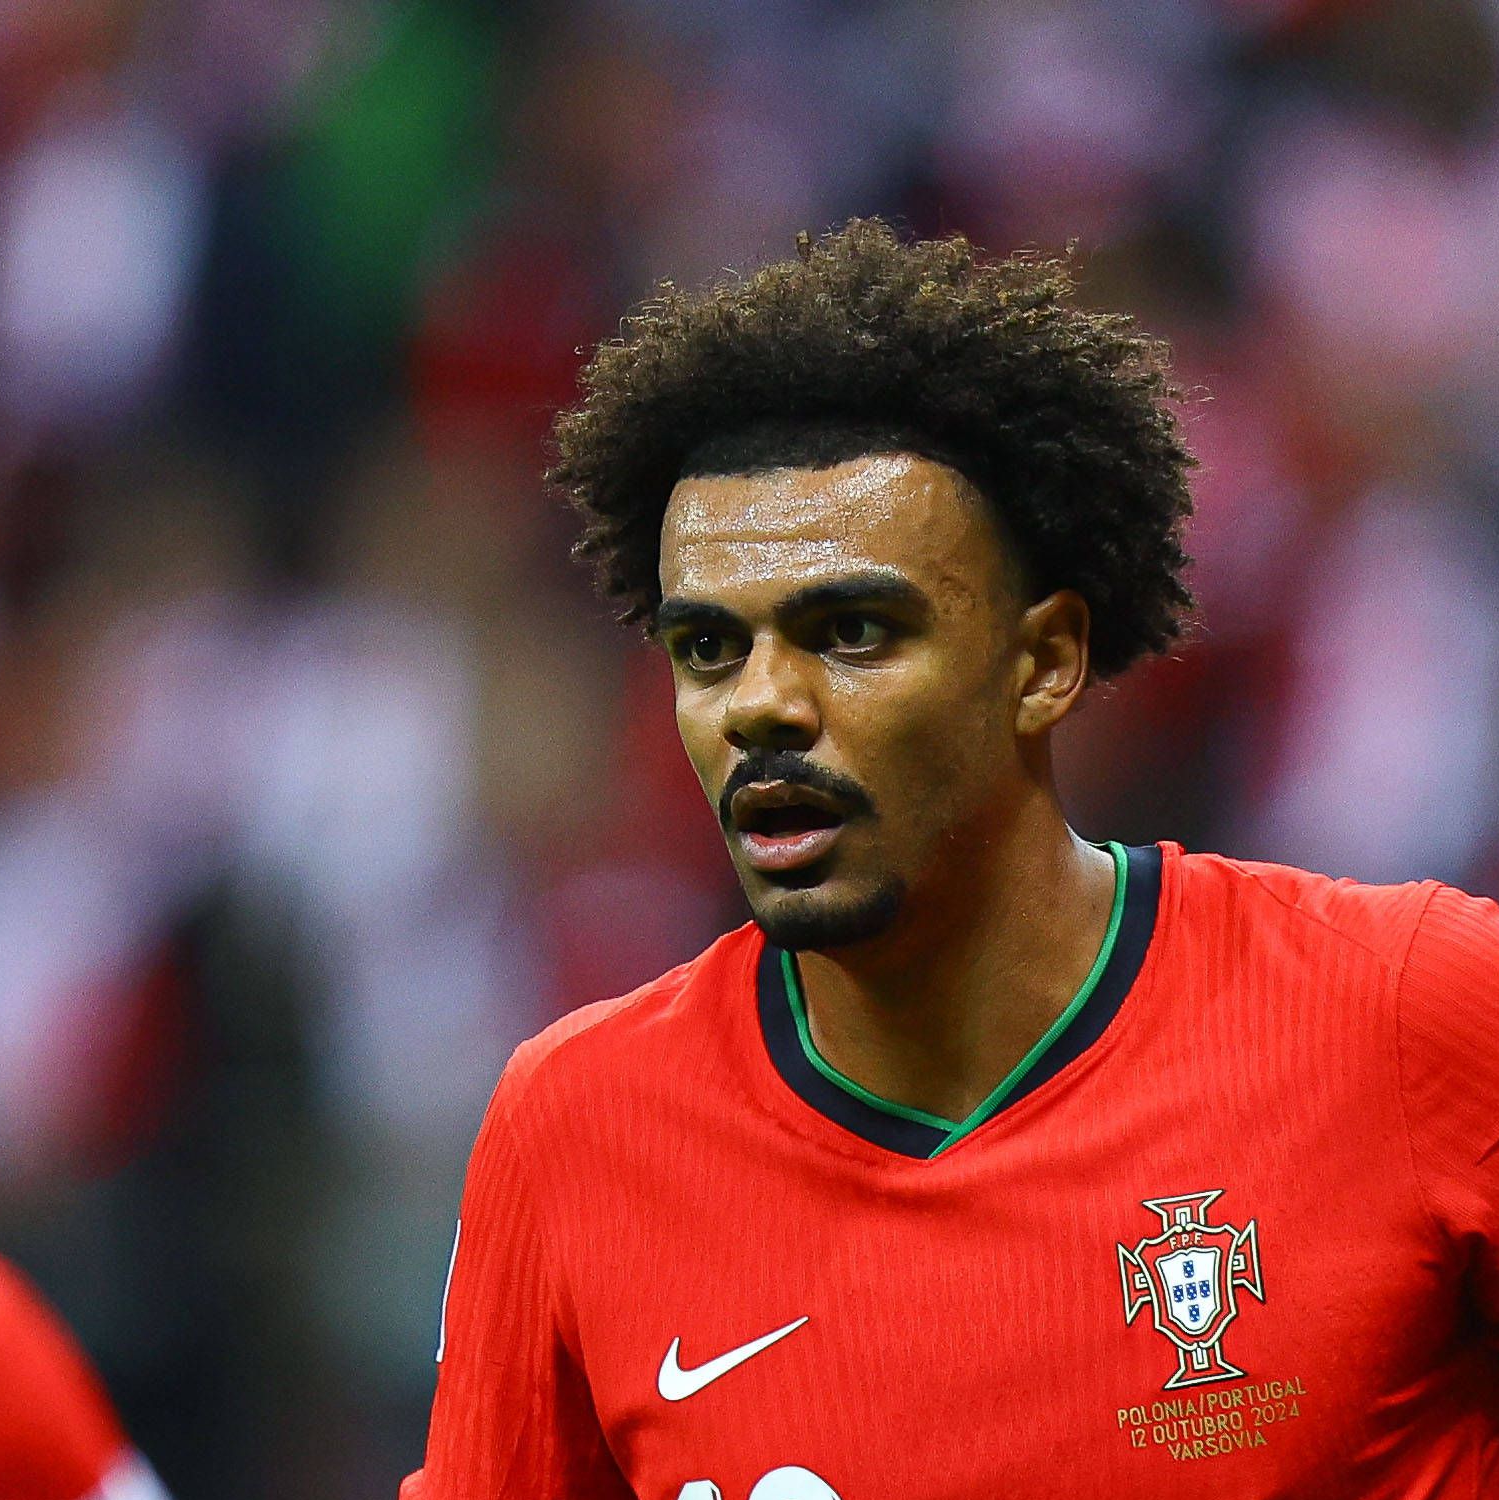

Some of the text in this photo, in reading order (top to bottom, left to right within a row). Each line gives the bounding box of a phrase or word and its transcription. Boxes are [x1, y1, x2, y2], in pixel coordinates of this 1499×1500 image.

[1131, 1400, 1300, 1448] 12 OUTUBRO 2024
